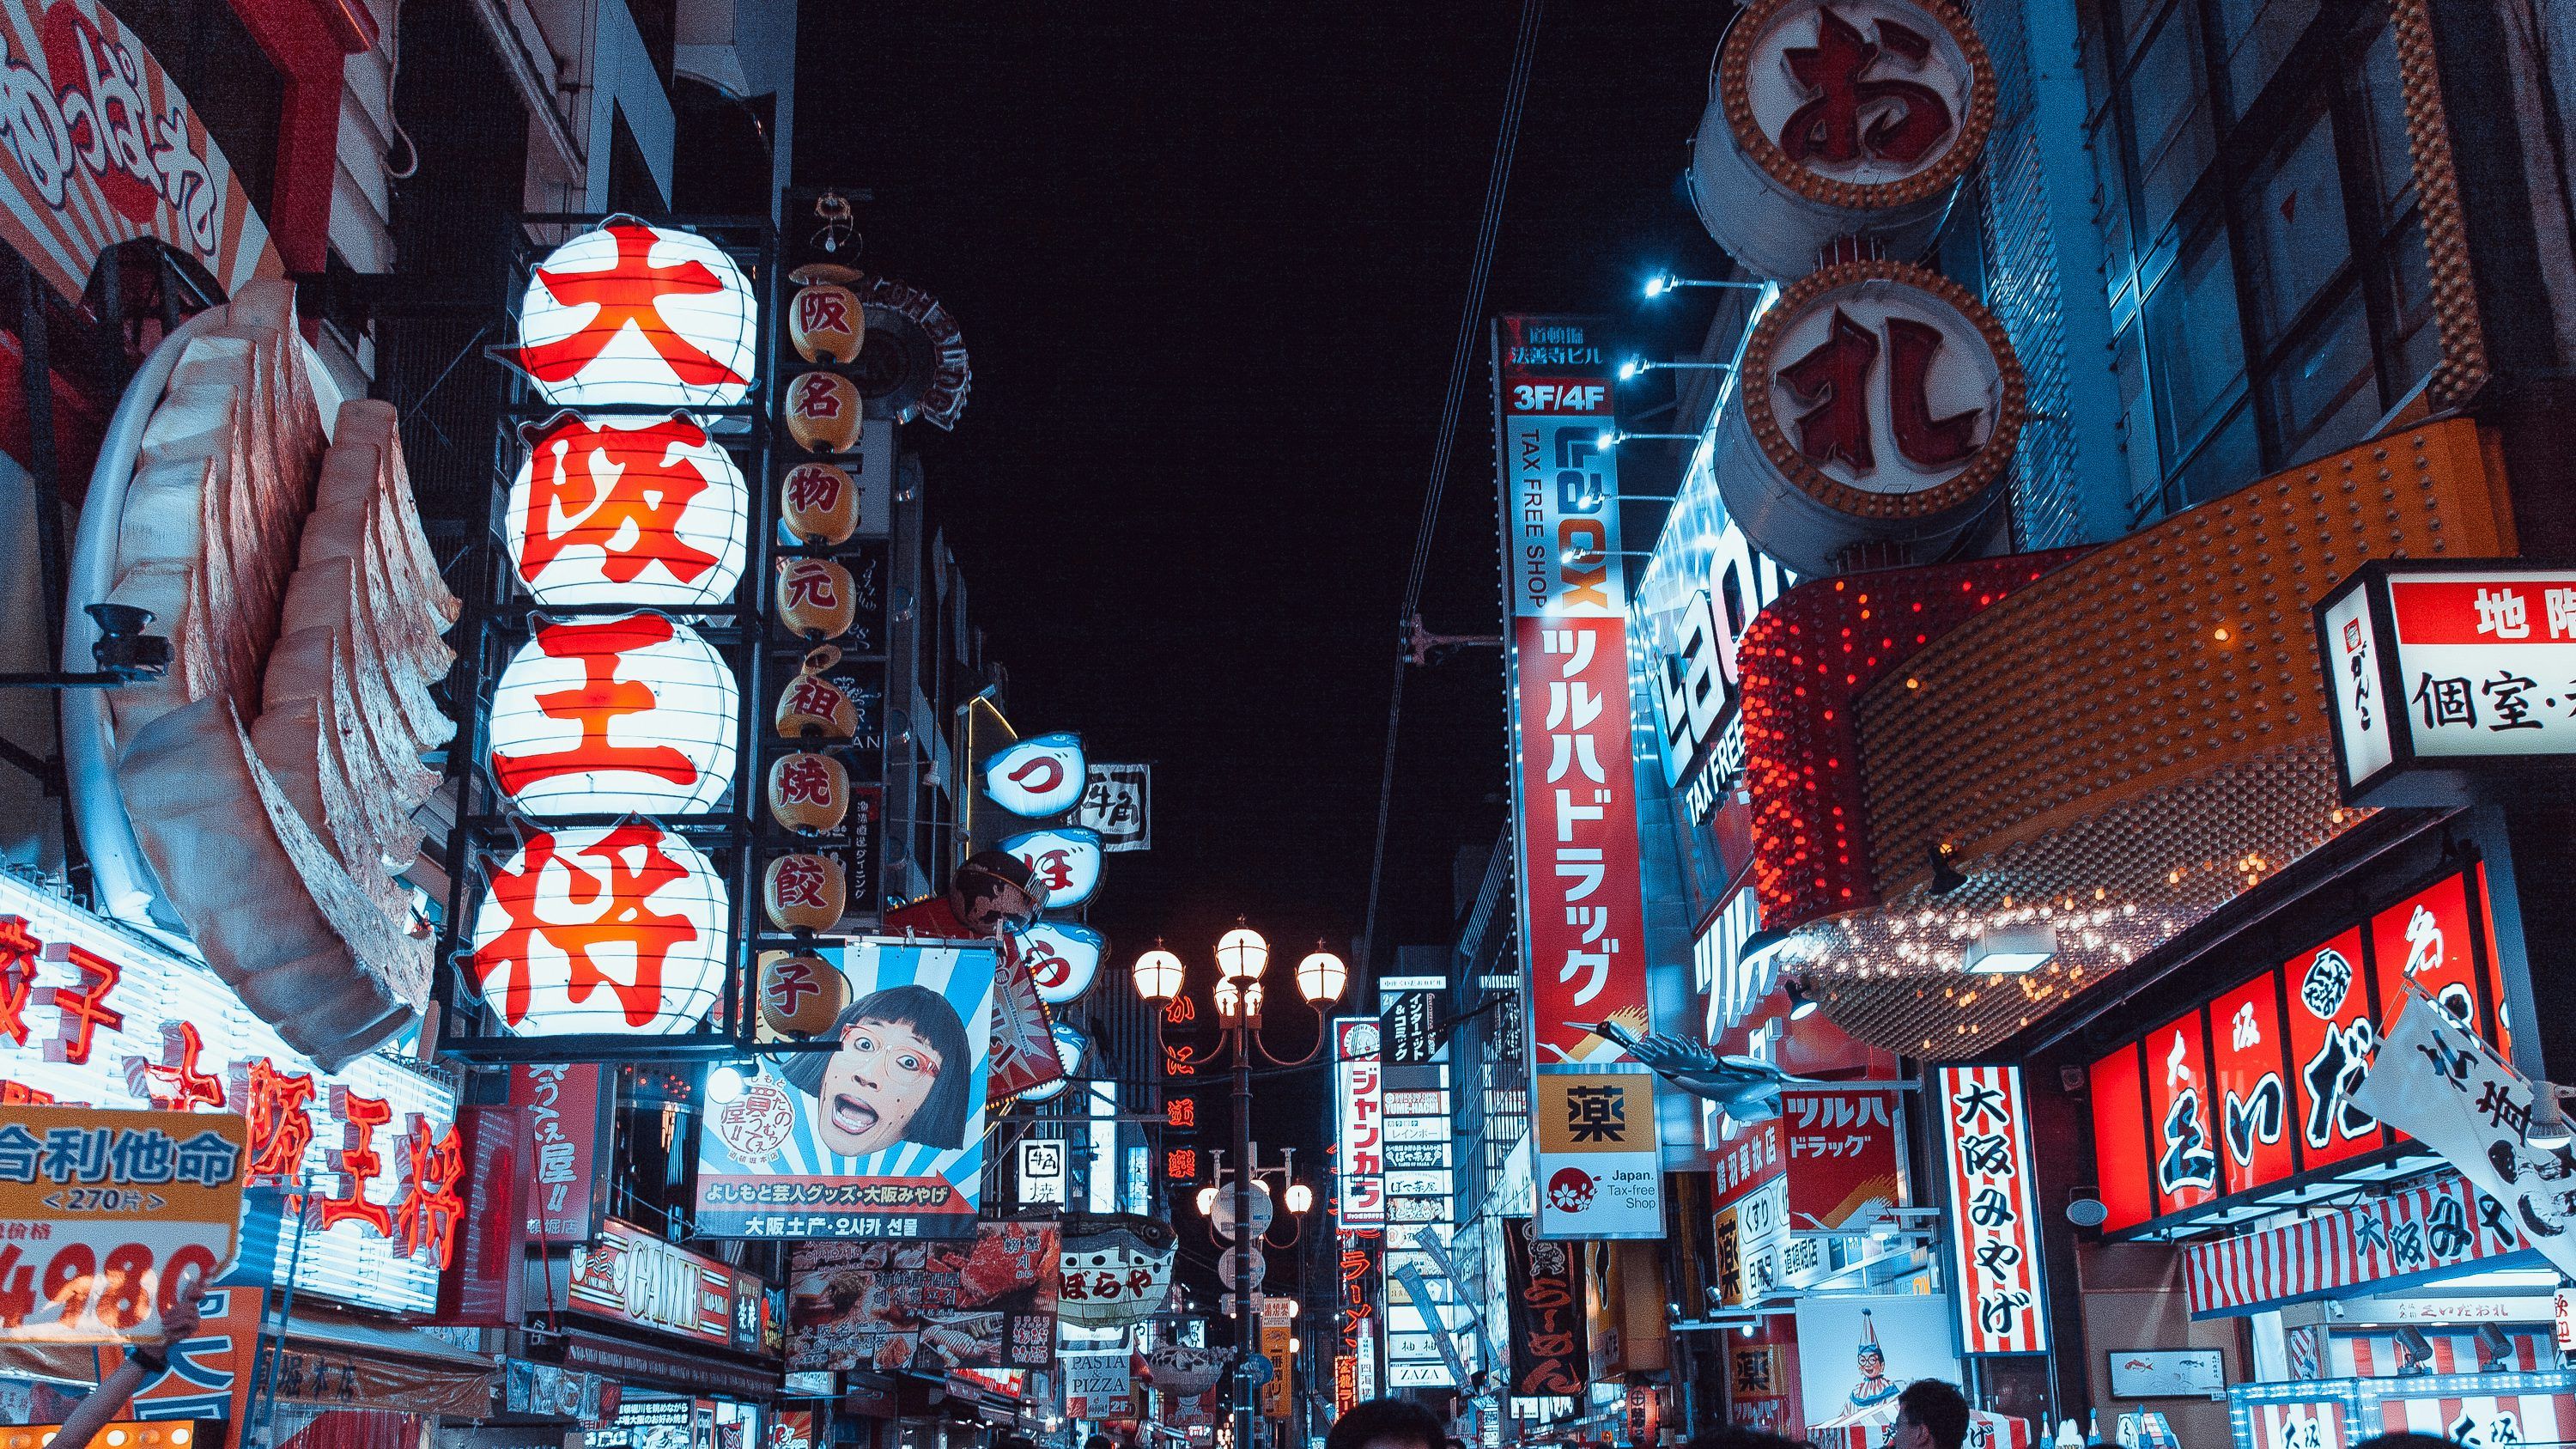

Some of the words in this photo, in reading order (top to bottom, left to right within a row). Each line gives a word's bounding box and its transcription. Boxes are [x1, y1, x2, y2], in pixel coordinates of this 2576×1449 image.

[1529, 326, 1583, 345] 道頓堀
[1511, 347, 1603, 366] 法善寺ビル
[1514, 385, 1605, 412] 3F/4F
[1521, 429, 1541, 472] TAX
[1524, 480, 1544, 539] FREE
[1555, 426, 1609, 610] Laox
[1527, 547, 1547, 608] SHOP
[453, 225, 752, 1029] 大阪王将
[1082, 783, 1140, 826] 牛角
[1686, 764, 1714, 828] TAX
[1541, 630, 1619, 1007] ツルハドラッグ
[1394, 1004, 1408, 1062] &コミック
[1409, 992, 1425, 1061] インターネット
[1166, 995, 1197, 1179] かに道楽
[1566, 1085, 1626, 1143] 薬
[1786, 1096, 1891, 1129] ツルハ
[1352, 1068, 1381, 1209] ジャンカラ
[1392, 1129, 1438, 1140] レインボー
[1789, 1135, 1873, 1159] ドラッグ
[707, 1184, 948, 1203] よしもと芸人グッズ・大阪みやげ
[1607, 1184, 1656, 1196] Tax-free
[1612, 1170, 1655, 1184] Japan.
[1625, 1197, 1656, 1211] Shop
[1744, 1196, 1770, 1233] くすり
[1955, 1084, 2032, 1336] 大阪みやげ
[1716, 1218, 1741, 1300] 薬
[1783, 1237, 1819, 1276] 道頓堀店
[627, 1240, 702, 1331] GAME
[875, 1272, 961, 1288] 海鮮居酒屋
[1522, 1277, 1583, 1397] らーめん
[1071, 1355, 1127, 1370] PASTA
[1400, 1369, 1439, 1380] ZAZA
[1736, 1350, 1771, 1391] 薬
[1072, 1376, 1127, 1393] PIZZA
[1110, 1400, 1129, 1413] 2F
